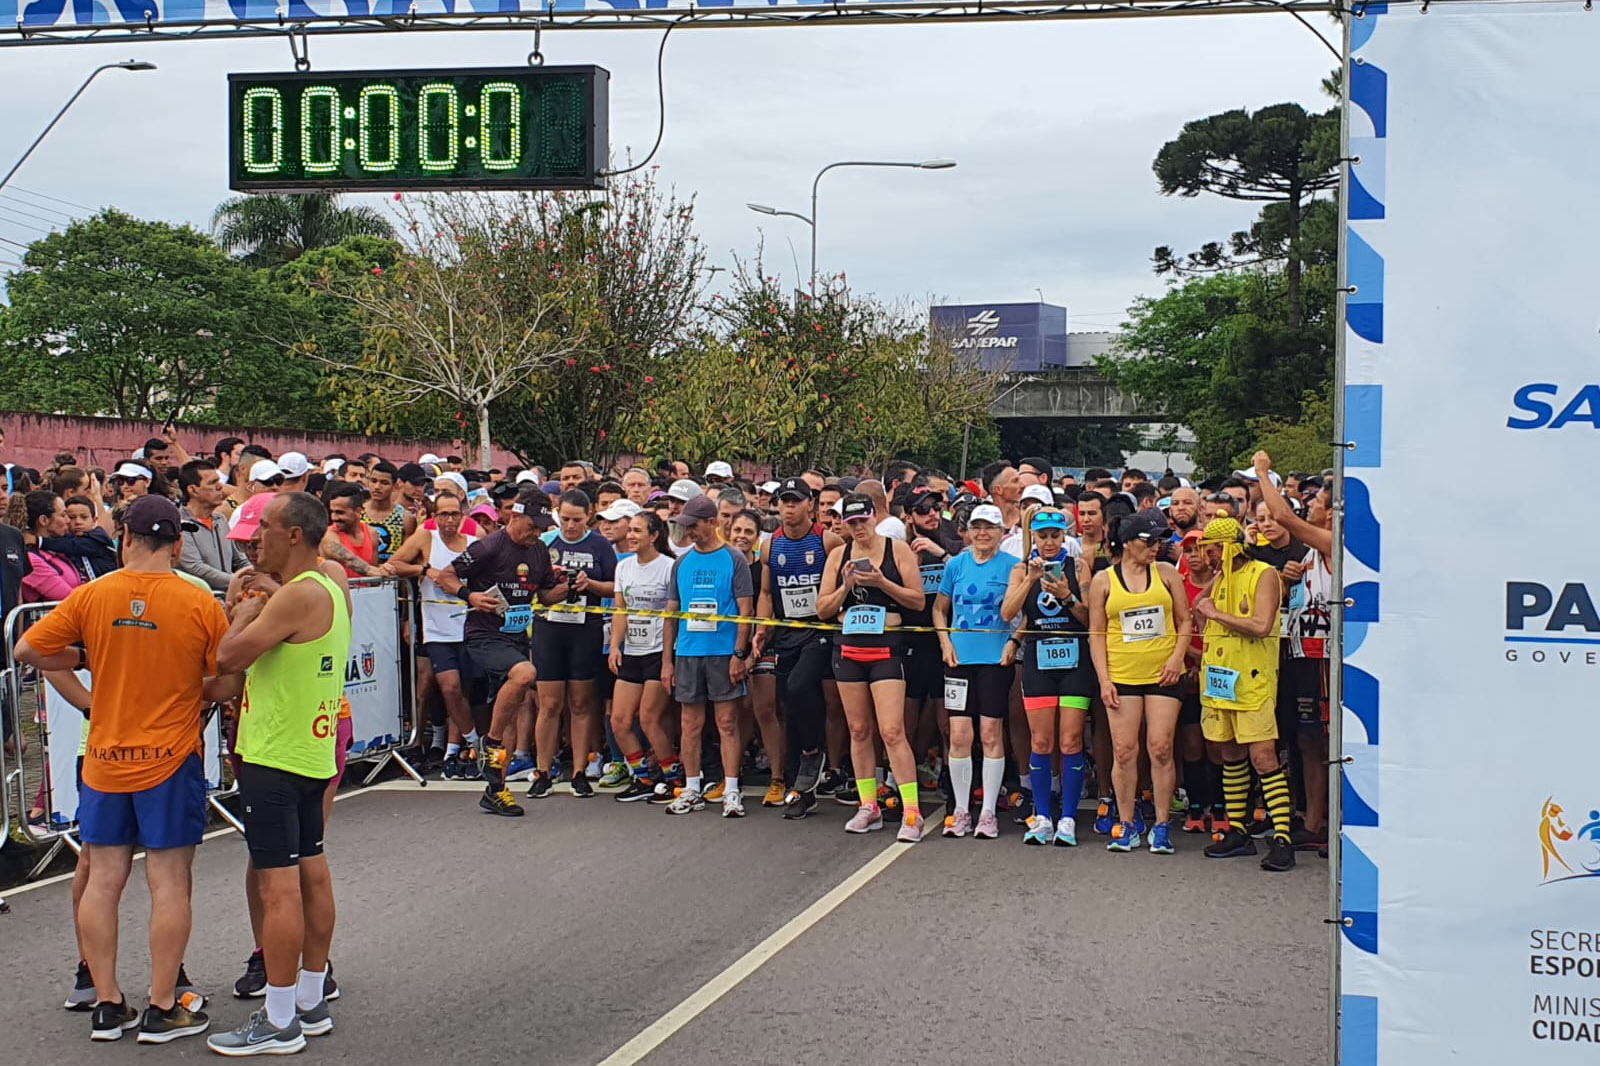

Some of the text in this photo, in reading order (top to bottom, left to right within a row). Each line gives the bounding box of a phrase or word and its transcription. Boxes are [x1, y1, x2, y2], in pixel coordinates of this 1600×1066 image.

[776, 573, 821, 587] BASE
[790, 598, 809, 609] 162
[509, 615, 530, 626] 1989
[851, 614, 877, 625] 2105
[1134, 618, 1154, 630] 612
[628, 627, 648, 638] 2315
[1046, 648, 1071, 659] 1881
[1210, 677, 1228, 689] 1824
